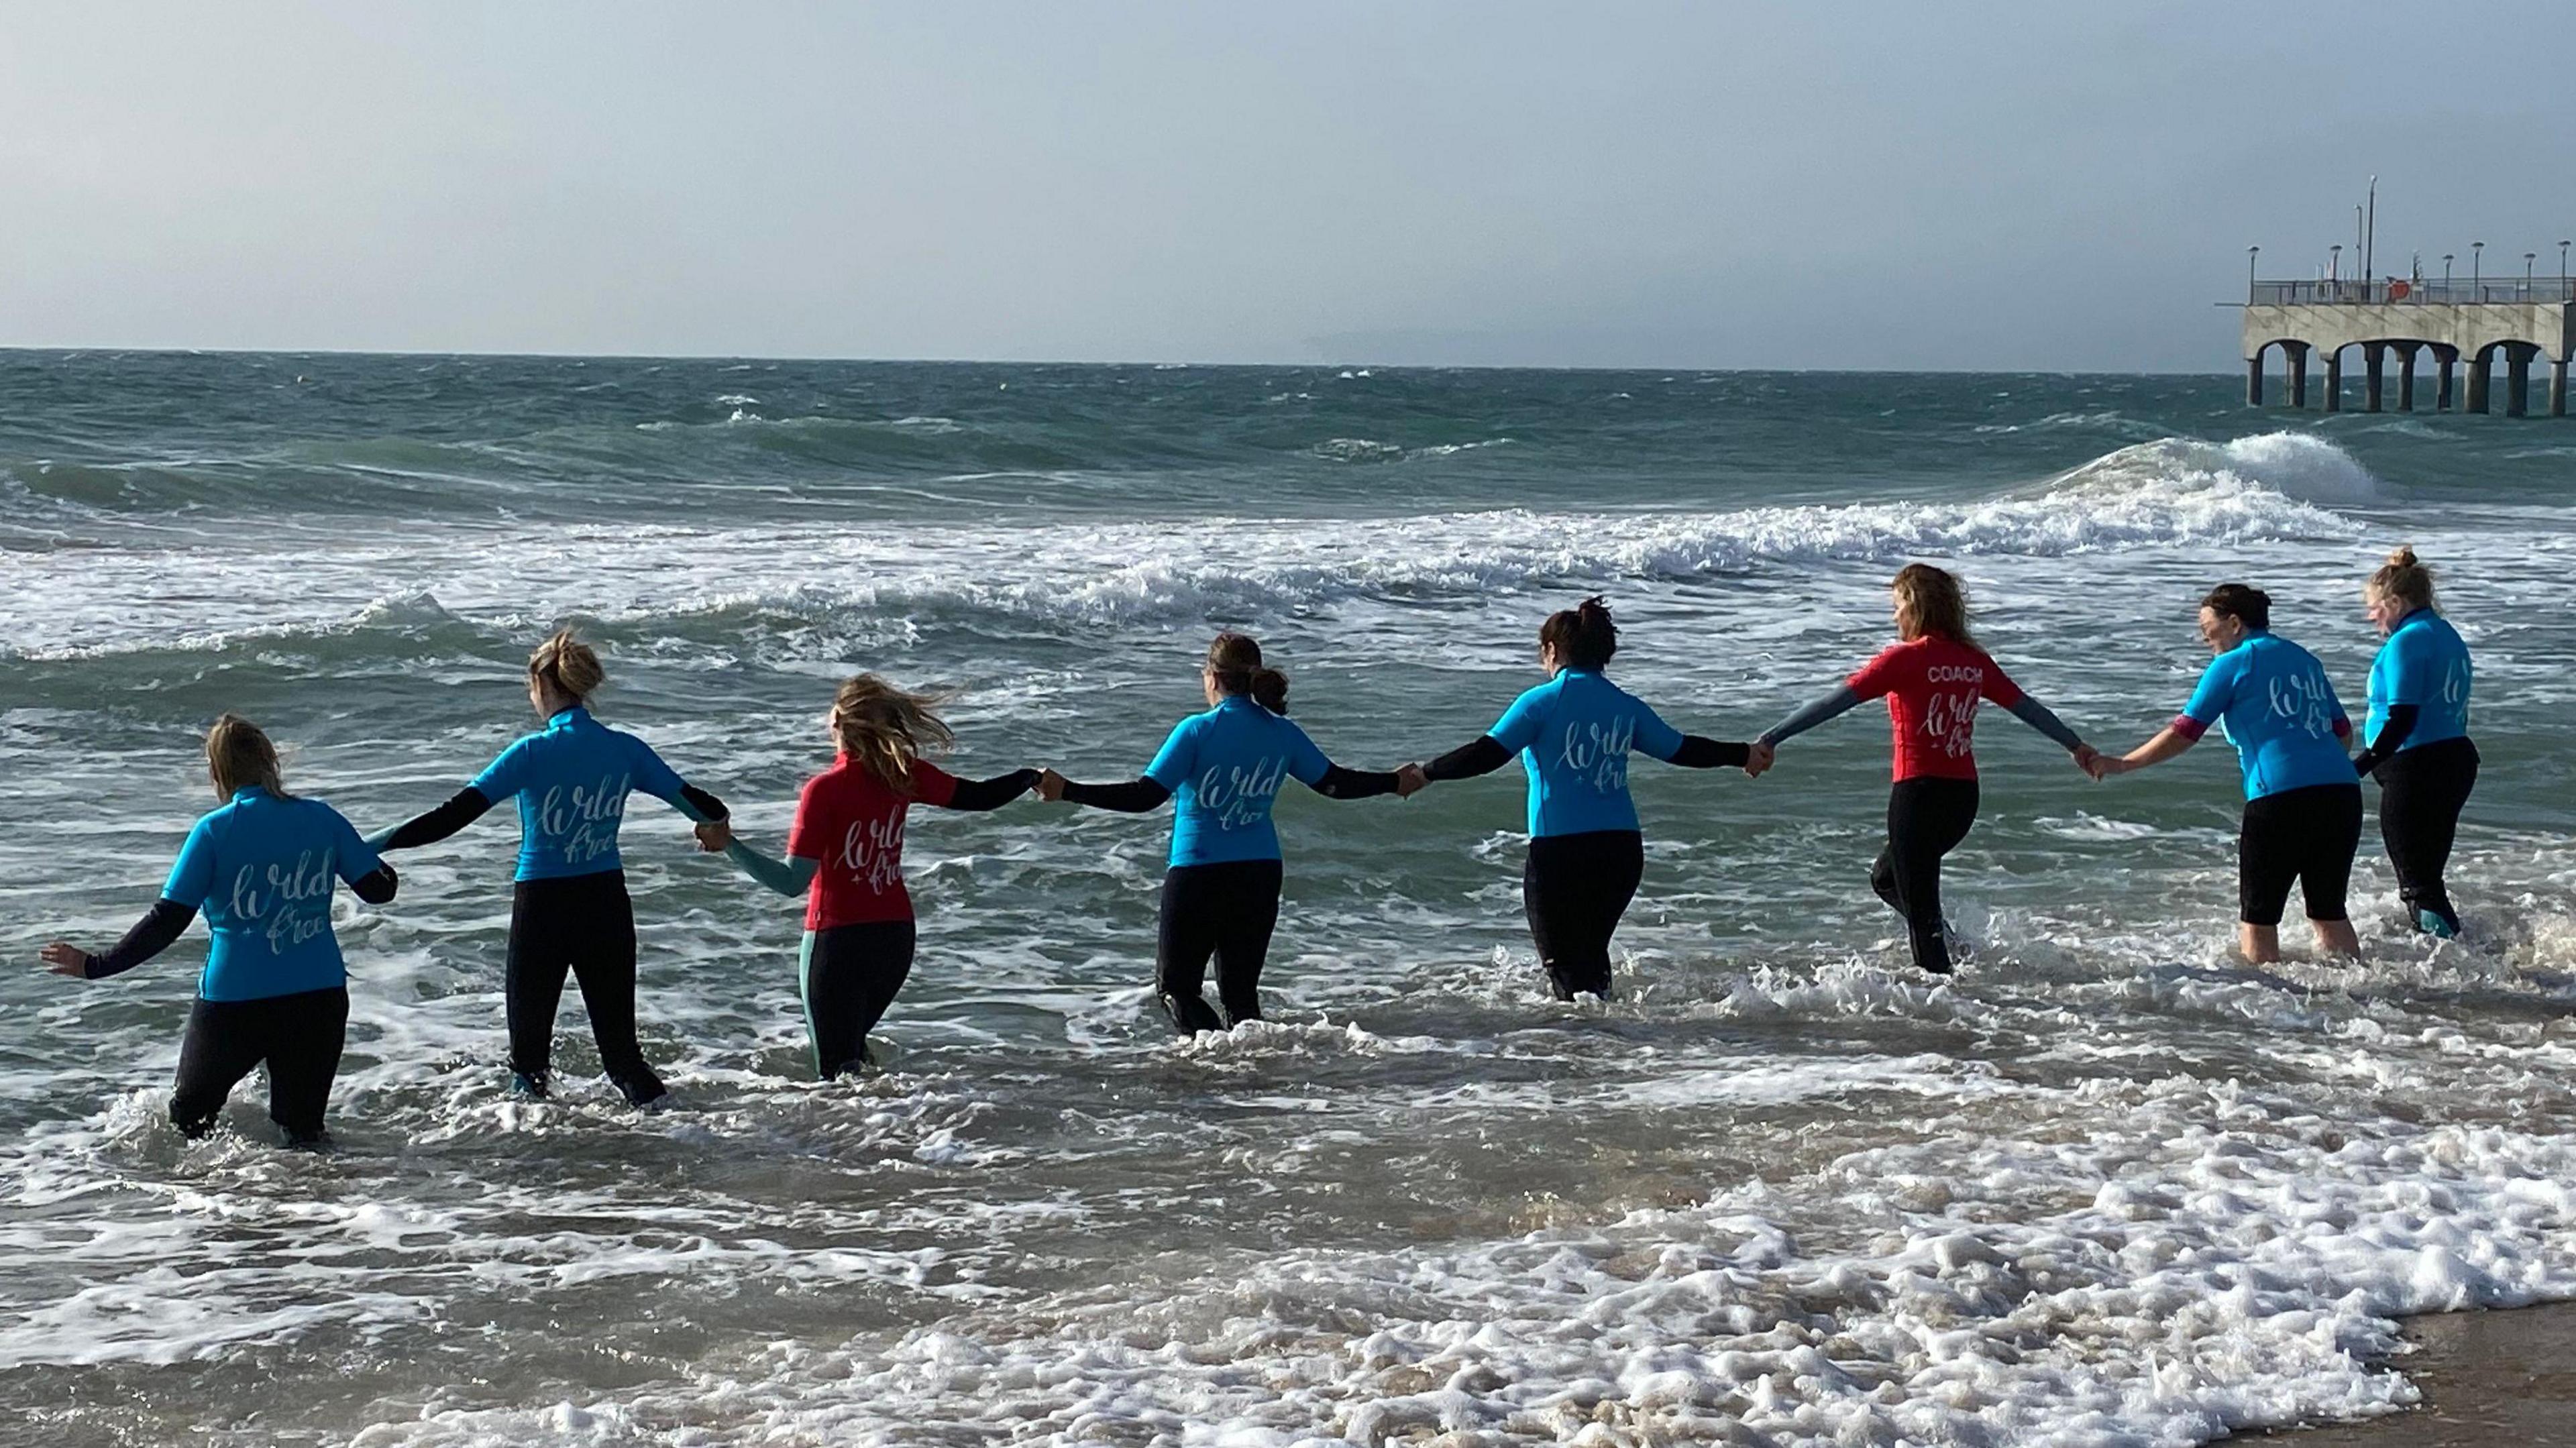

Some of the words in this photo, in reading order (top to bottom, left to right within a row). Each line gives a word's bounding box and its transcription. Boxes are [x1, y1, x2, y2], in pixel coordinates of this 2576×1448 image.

[1927, 665, 1983, 683] COACH
[533, 773, 630, 836] Wild
[1197, 756, 1285, 808] Wild
[222, 847, 333, 921] Wild
[266, 903, 326, 956] free
